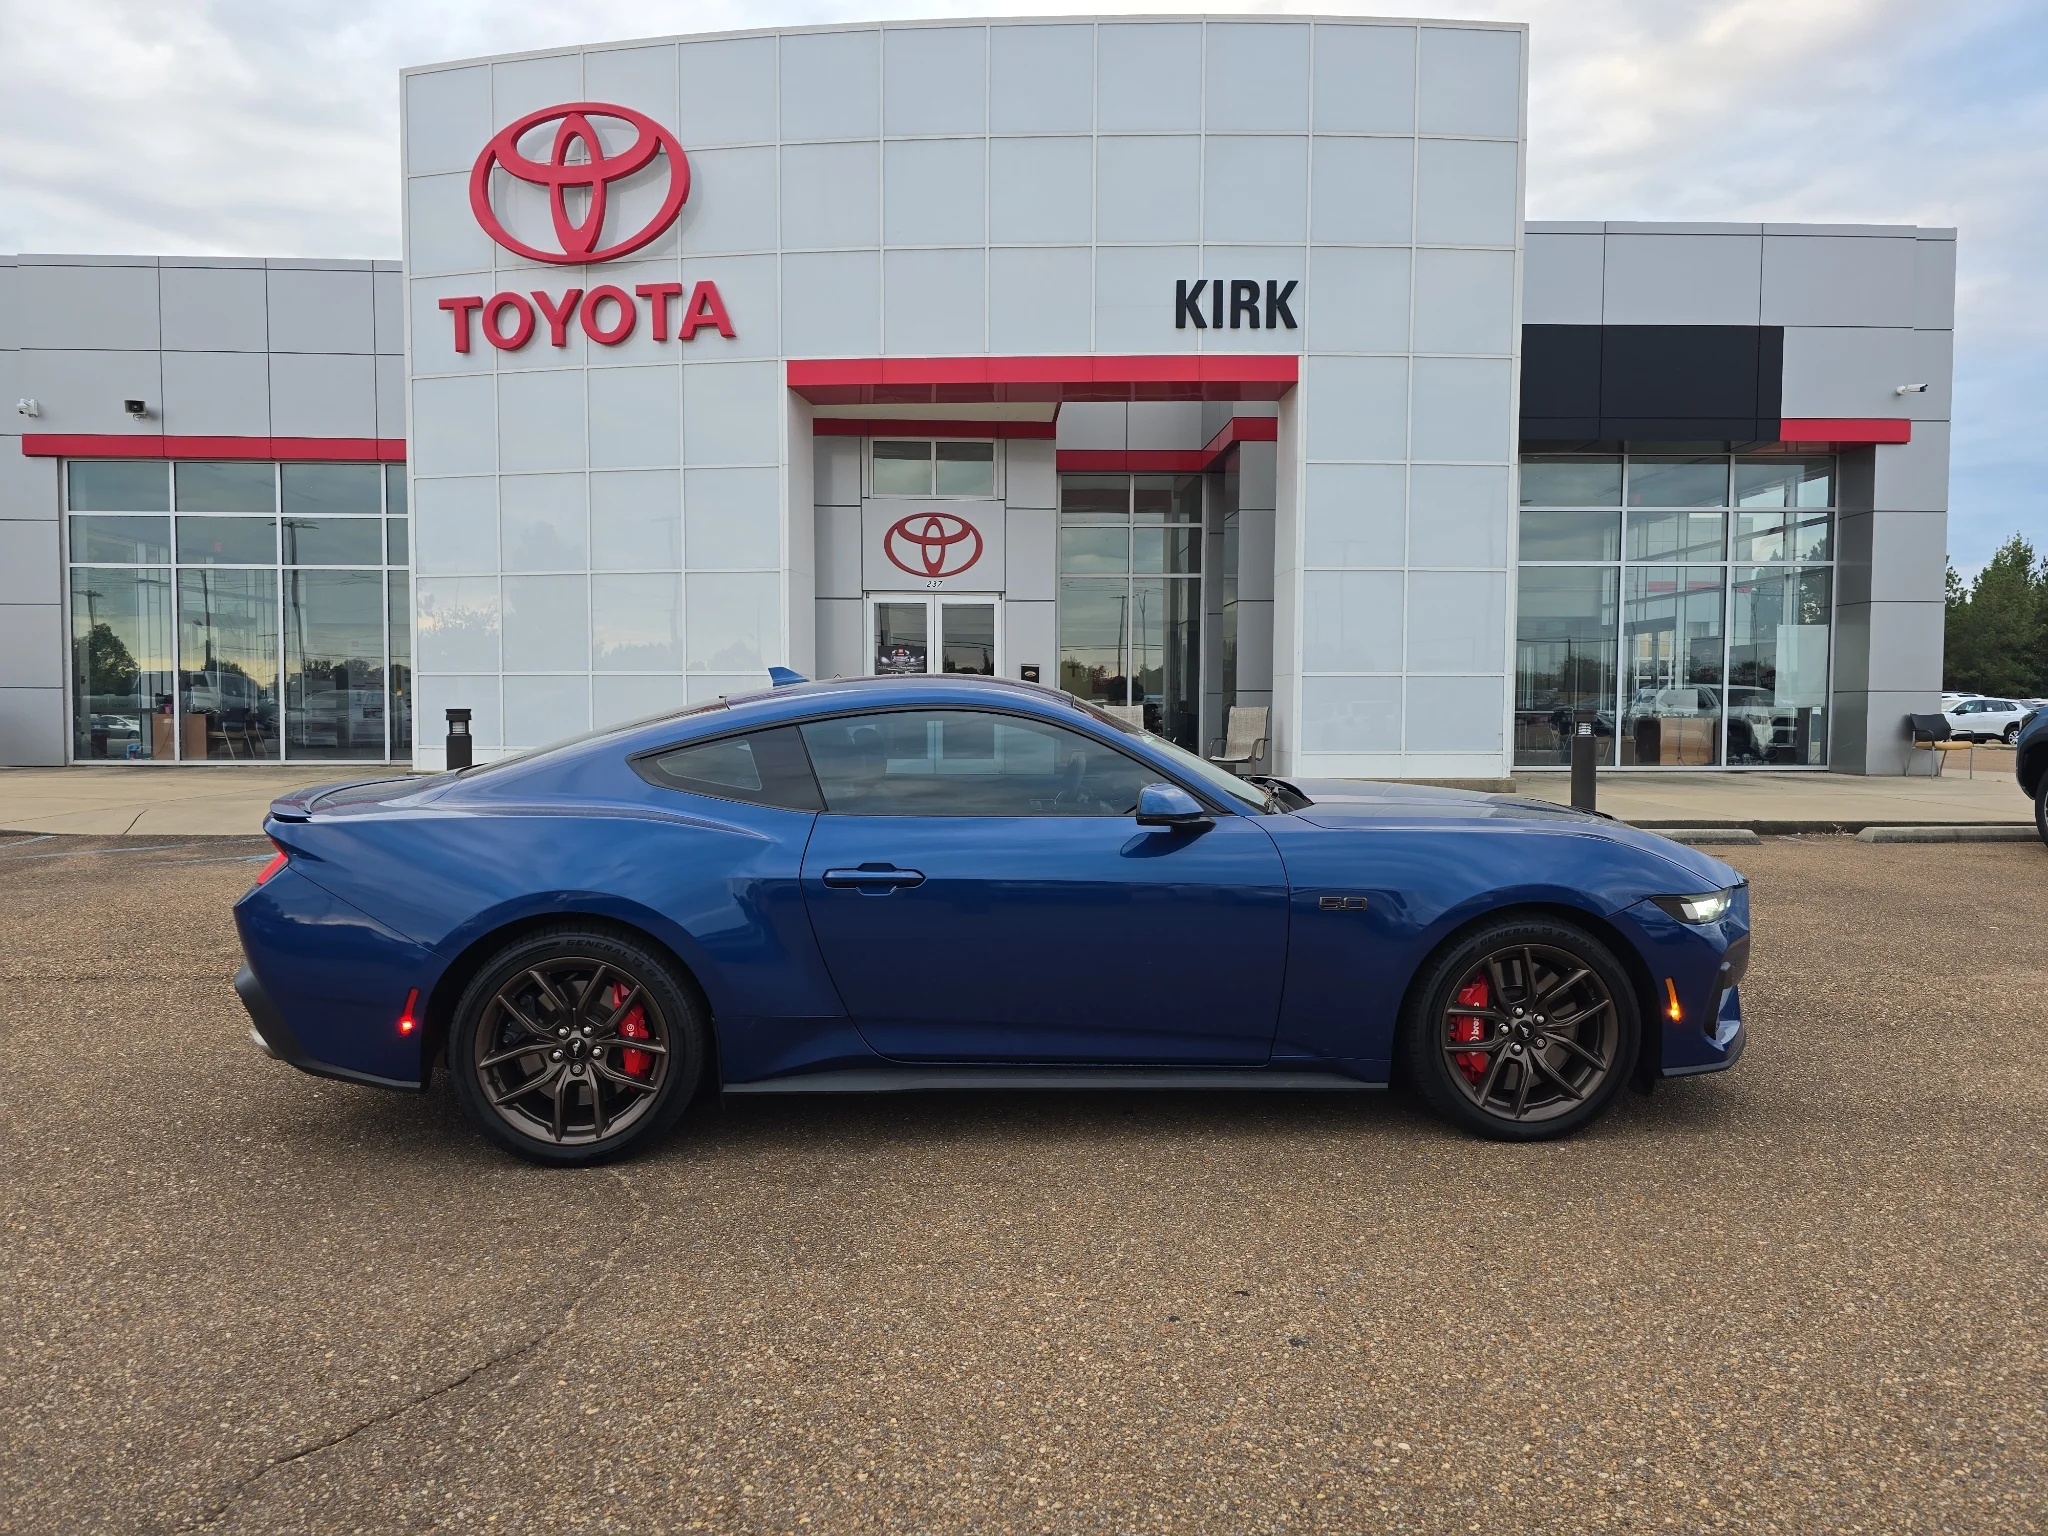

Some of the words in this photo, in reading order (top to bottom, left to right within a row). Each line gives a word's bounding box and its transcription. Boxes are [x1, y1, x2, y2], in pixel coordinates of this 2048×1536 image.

[1175, 279, 1299, 329] KIRK
[438, 280, 737, 354] TOYOTA
[926, 580, 943, 588] 237
[1319, 896, 1368, 911] 5.0
[1480, 926, 1537, 946] GENERAL
[566, 939, 629, 960] GENERAL
